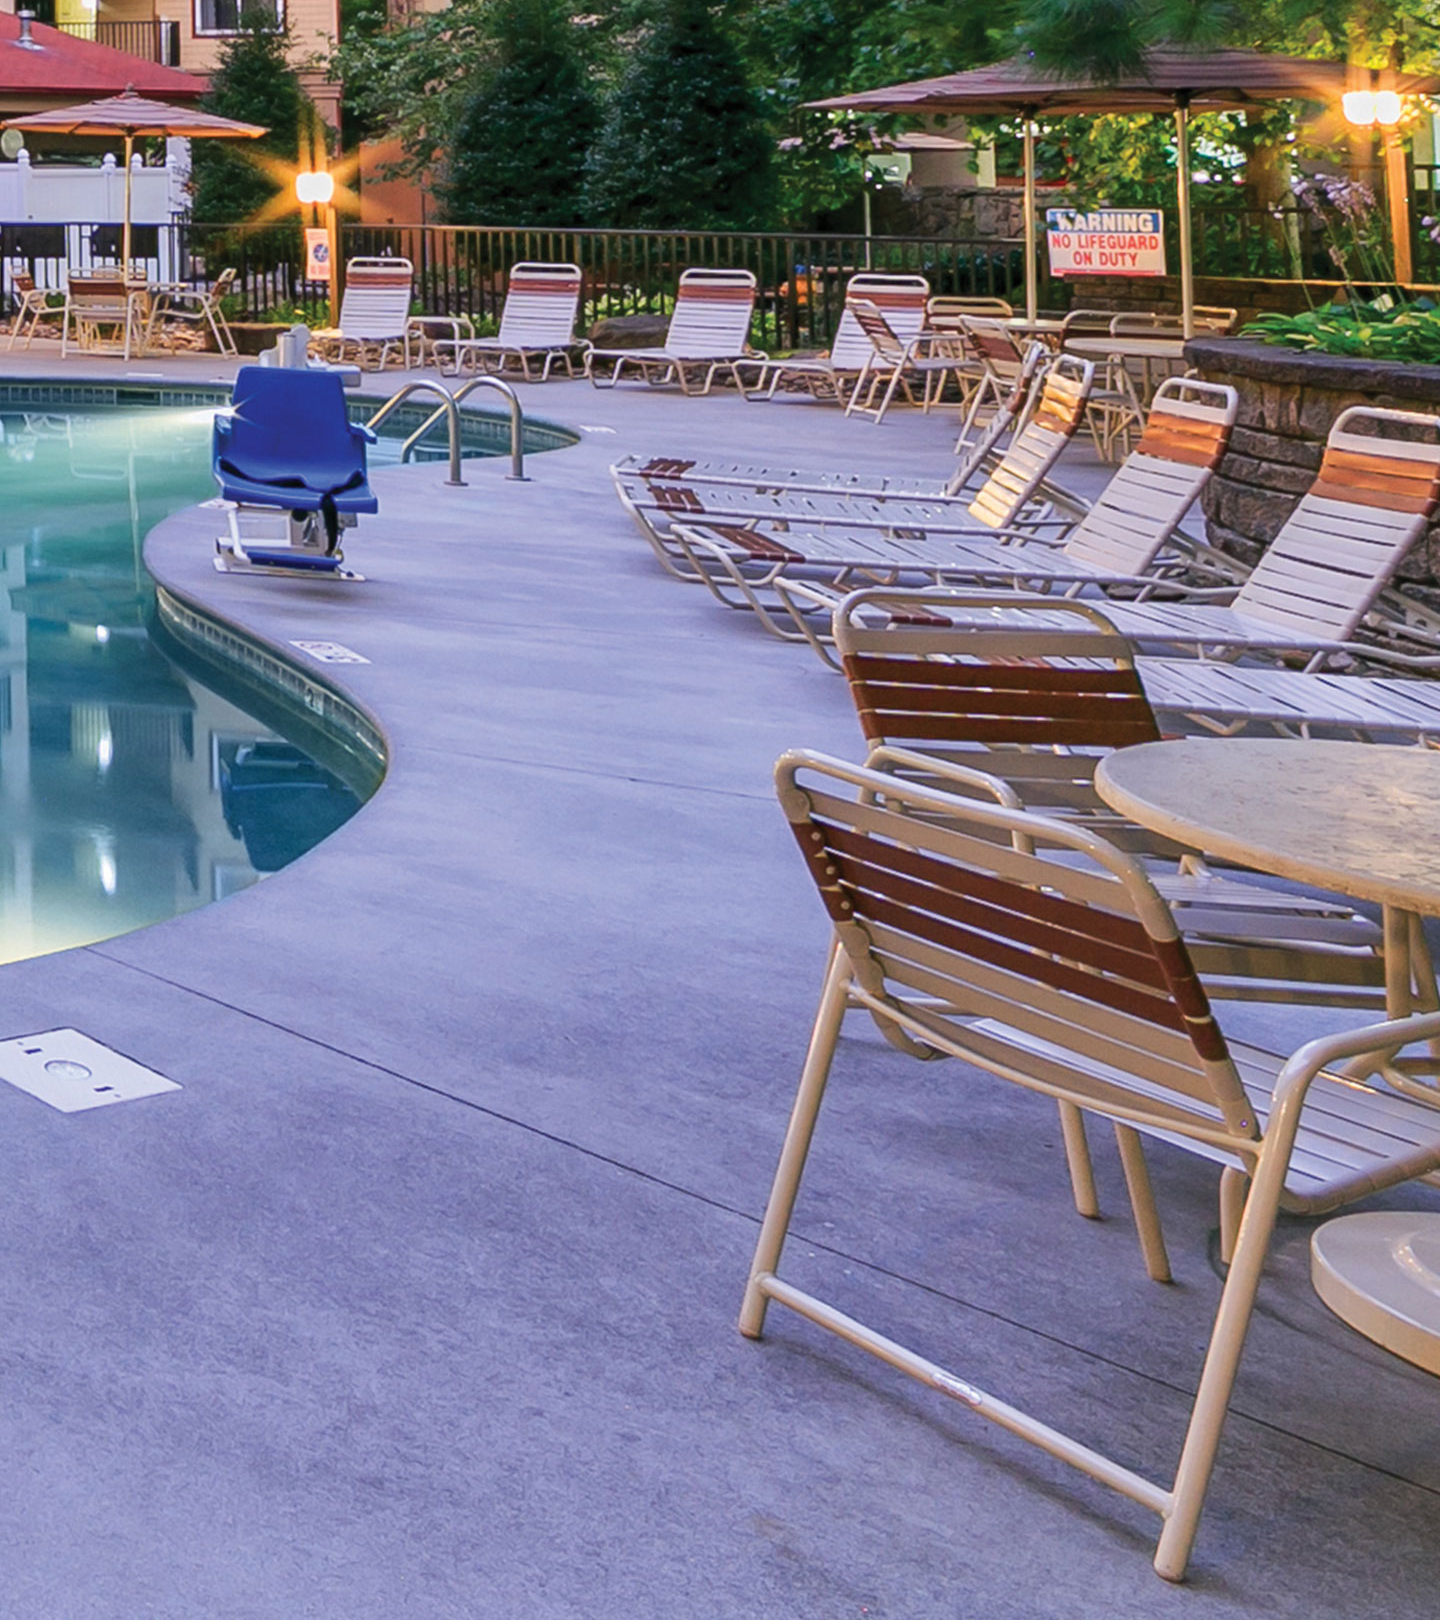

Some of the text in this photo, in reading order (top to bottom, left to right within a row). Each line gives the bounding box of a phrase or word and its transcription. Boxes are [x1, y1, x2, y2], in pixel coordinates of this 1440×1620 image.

[1052, 235, 1159, 251] NO LIFEGUARD
[1073, 251, 1138, 266] ON DUTY
